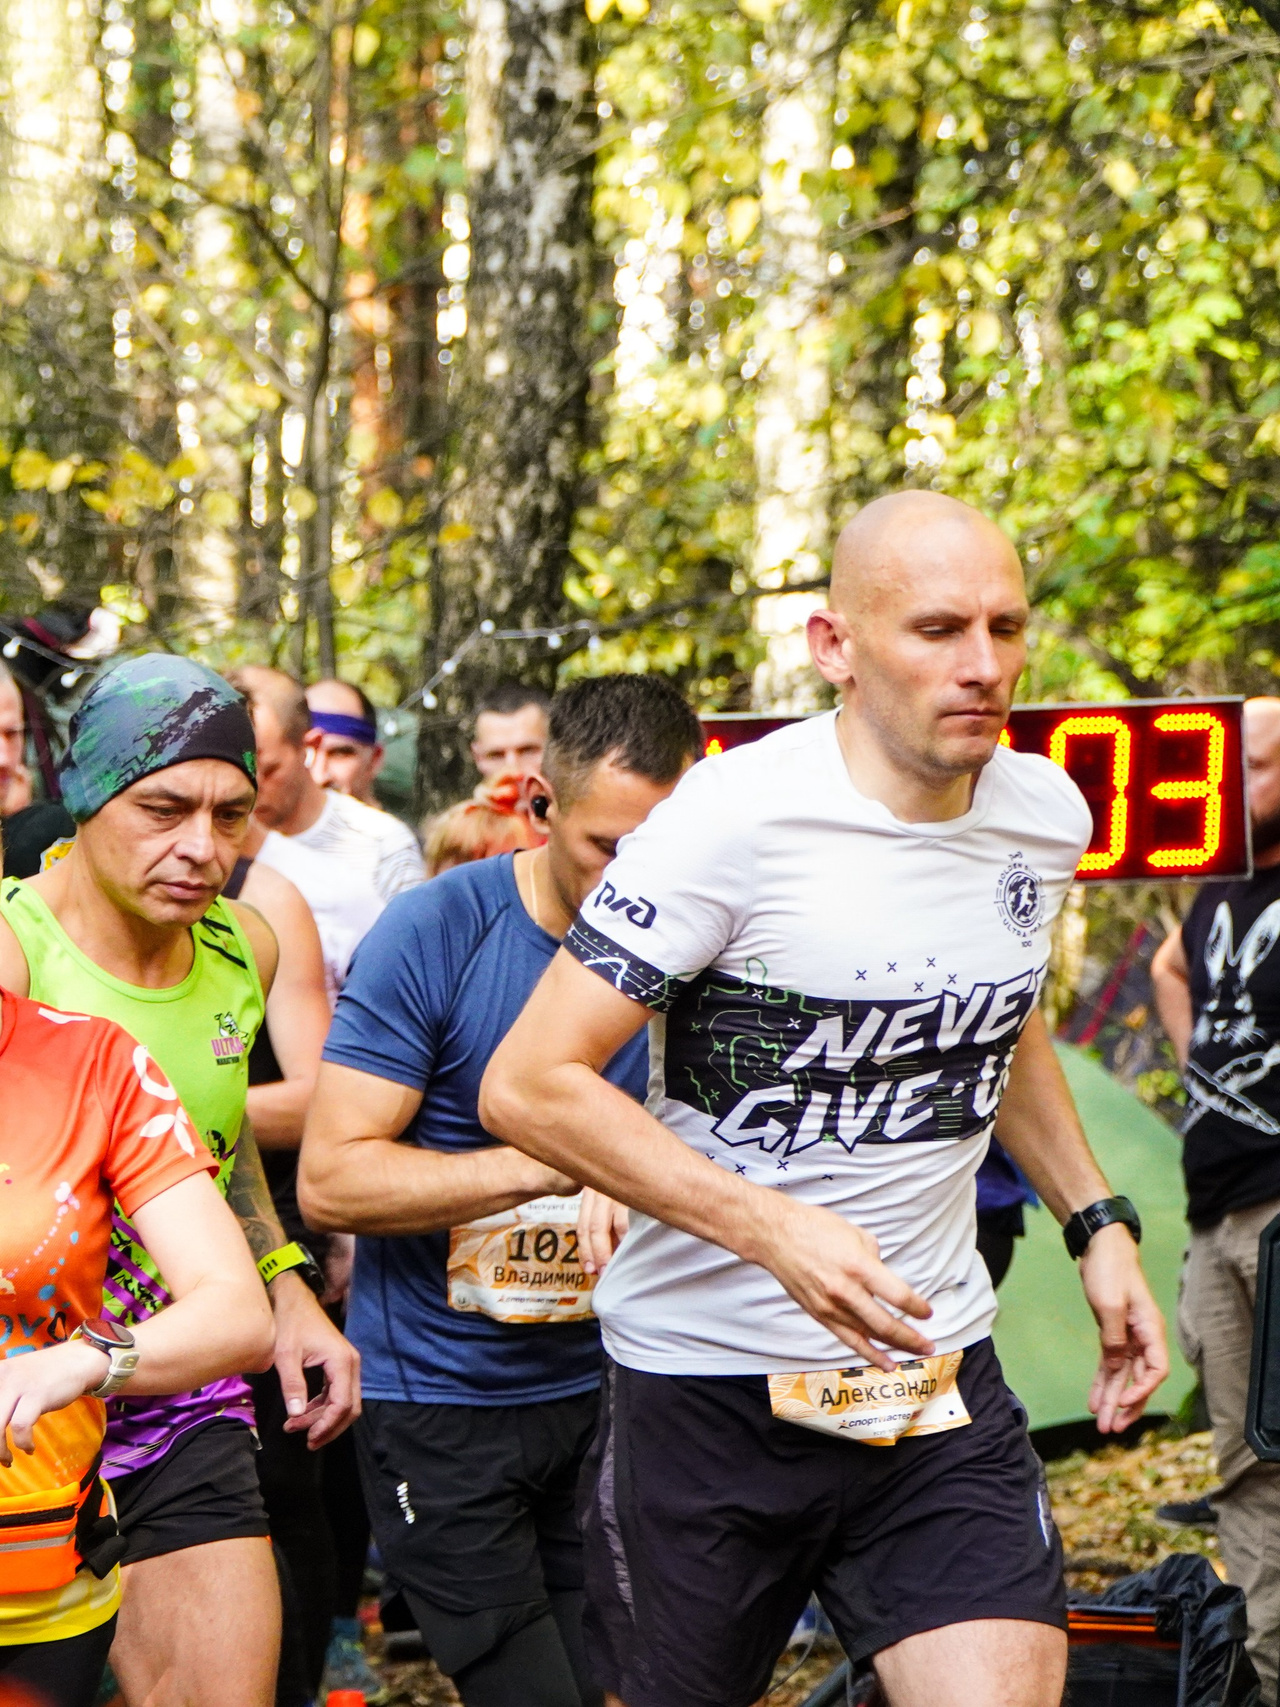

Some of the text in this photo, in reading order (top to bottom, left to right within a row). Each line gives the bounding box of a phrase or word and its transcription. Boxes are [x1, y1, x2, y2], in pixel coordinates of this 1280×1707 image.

[1003, 918, 1027, 938] ULTRA
[211, 1036, 245, 1056] ULTRA
[711, 1069, 943, 1157] GIVE
[509, 1229, 580, 1264] 102
[494, 1266, 586, 1288] Владимир
[821, 1377, 937, 1407] Александр
